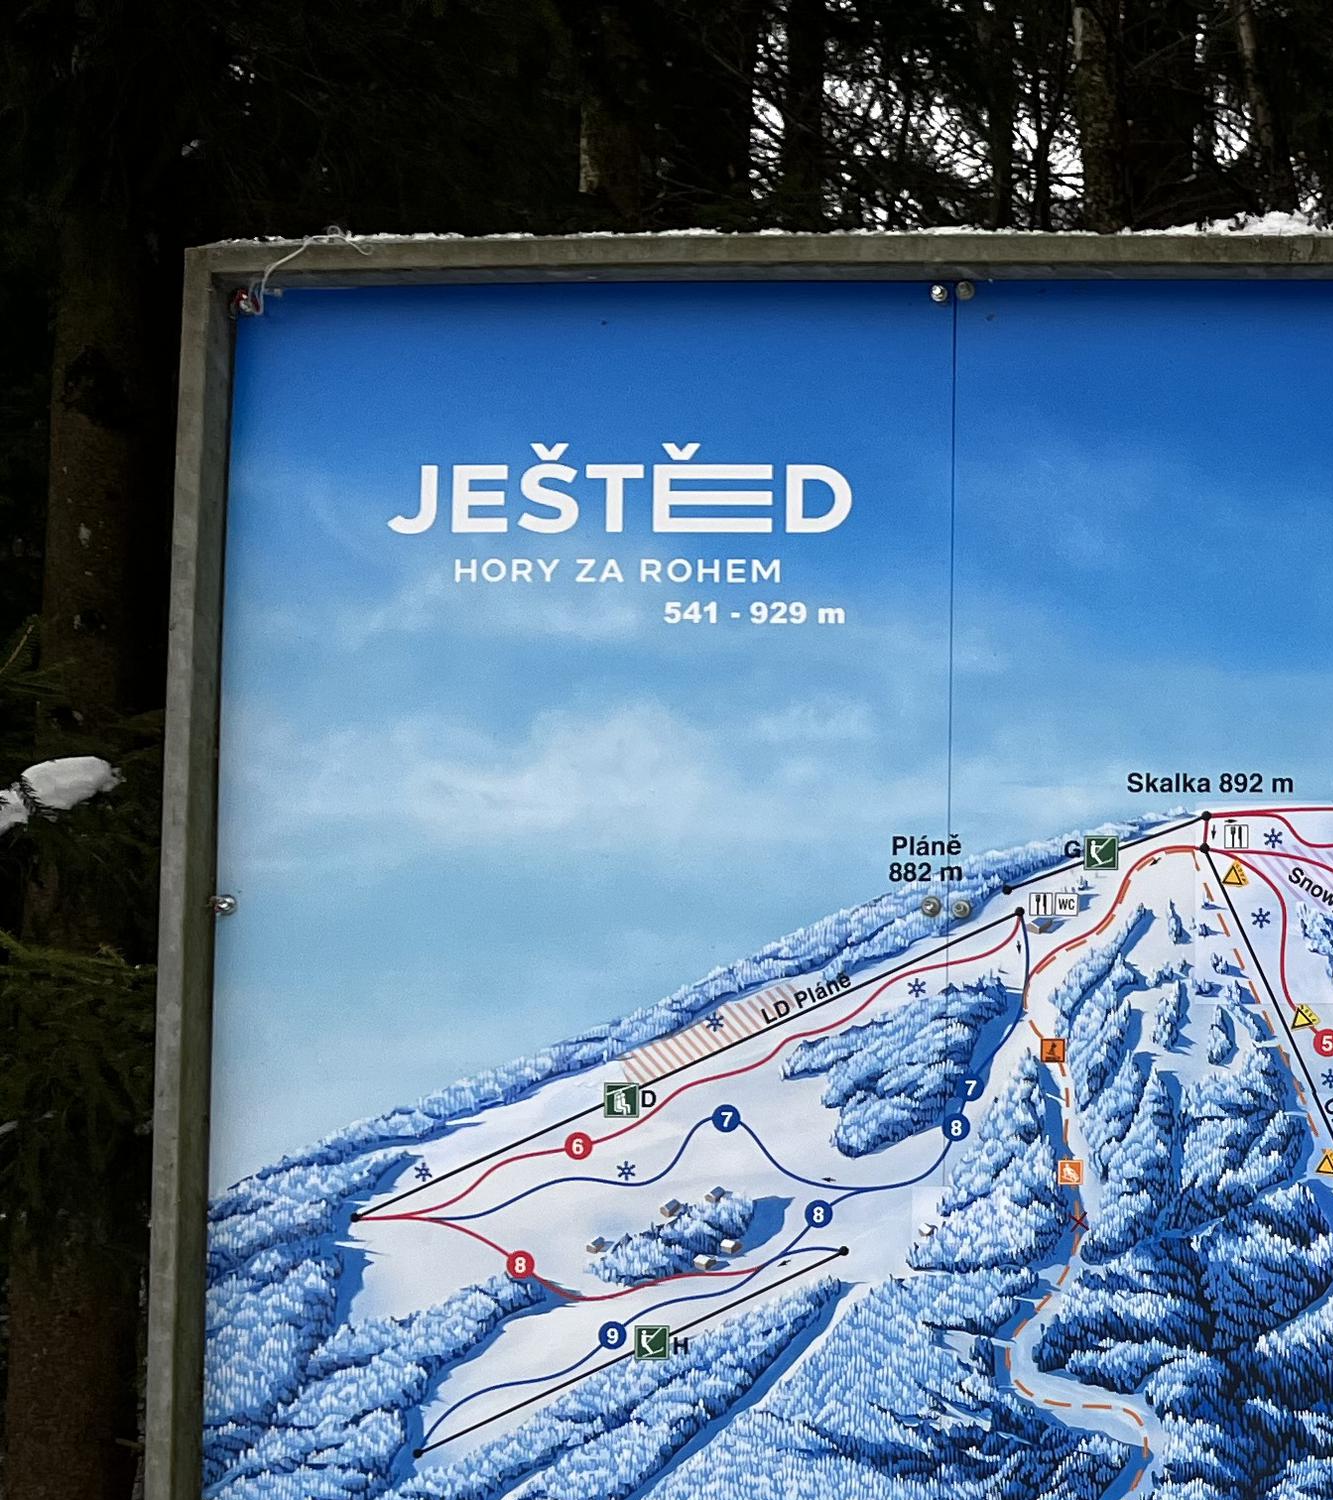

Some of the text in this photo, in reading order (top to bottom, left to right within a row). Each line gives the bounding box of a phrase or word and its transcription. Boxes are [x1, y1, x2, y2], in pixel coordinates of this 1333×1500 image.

[387, 442, 852, 535] JEŠTĚD
[454, 558, 780, 583] HORY ZA ROHEM
[663, 601, 717, 624] 541
[750, 601, 807, 625] 929
[818, 607, 845, 624] m
[1127, 772, 1294, 794] Skalka 892 m
[892, 832, 962, 857] Pláně
[888, 861, 964, 883] 882 m
[761, 1000, 790, 1024] LD
